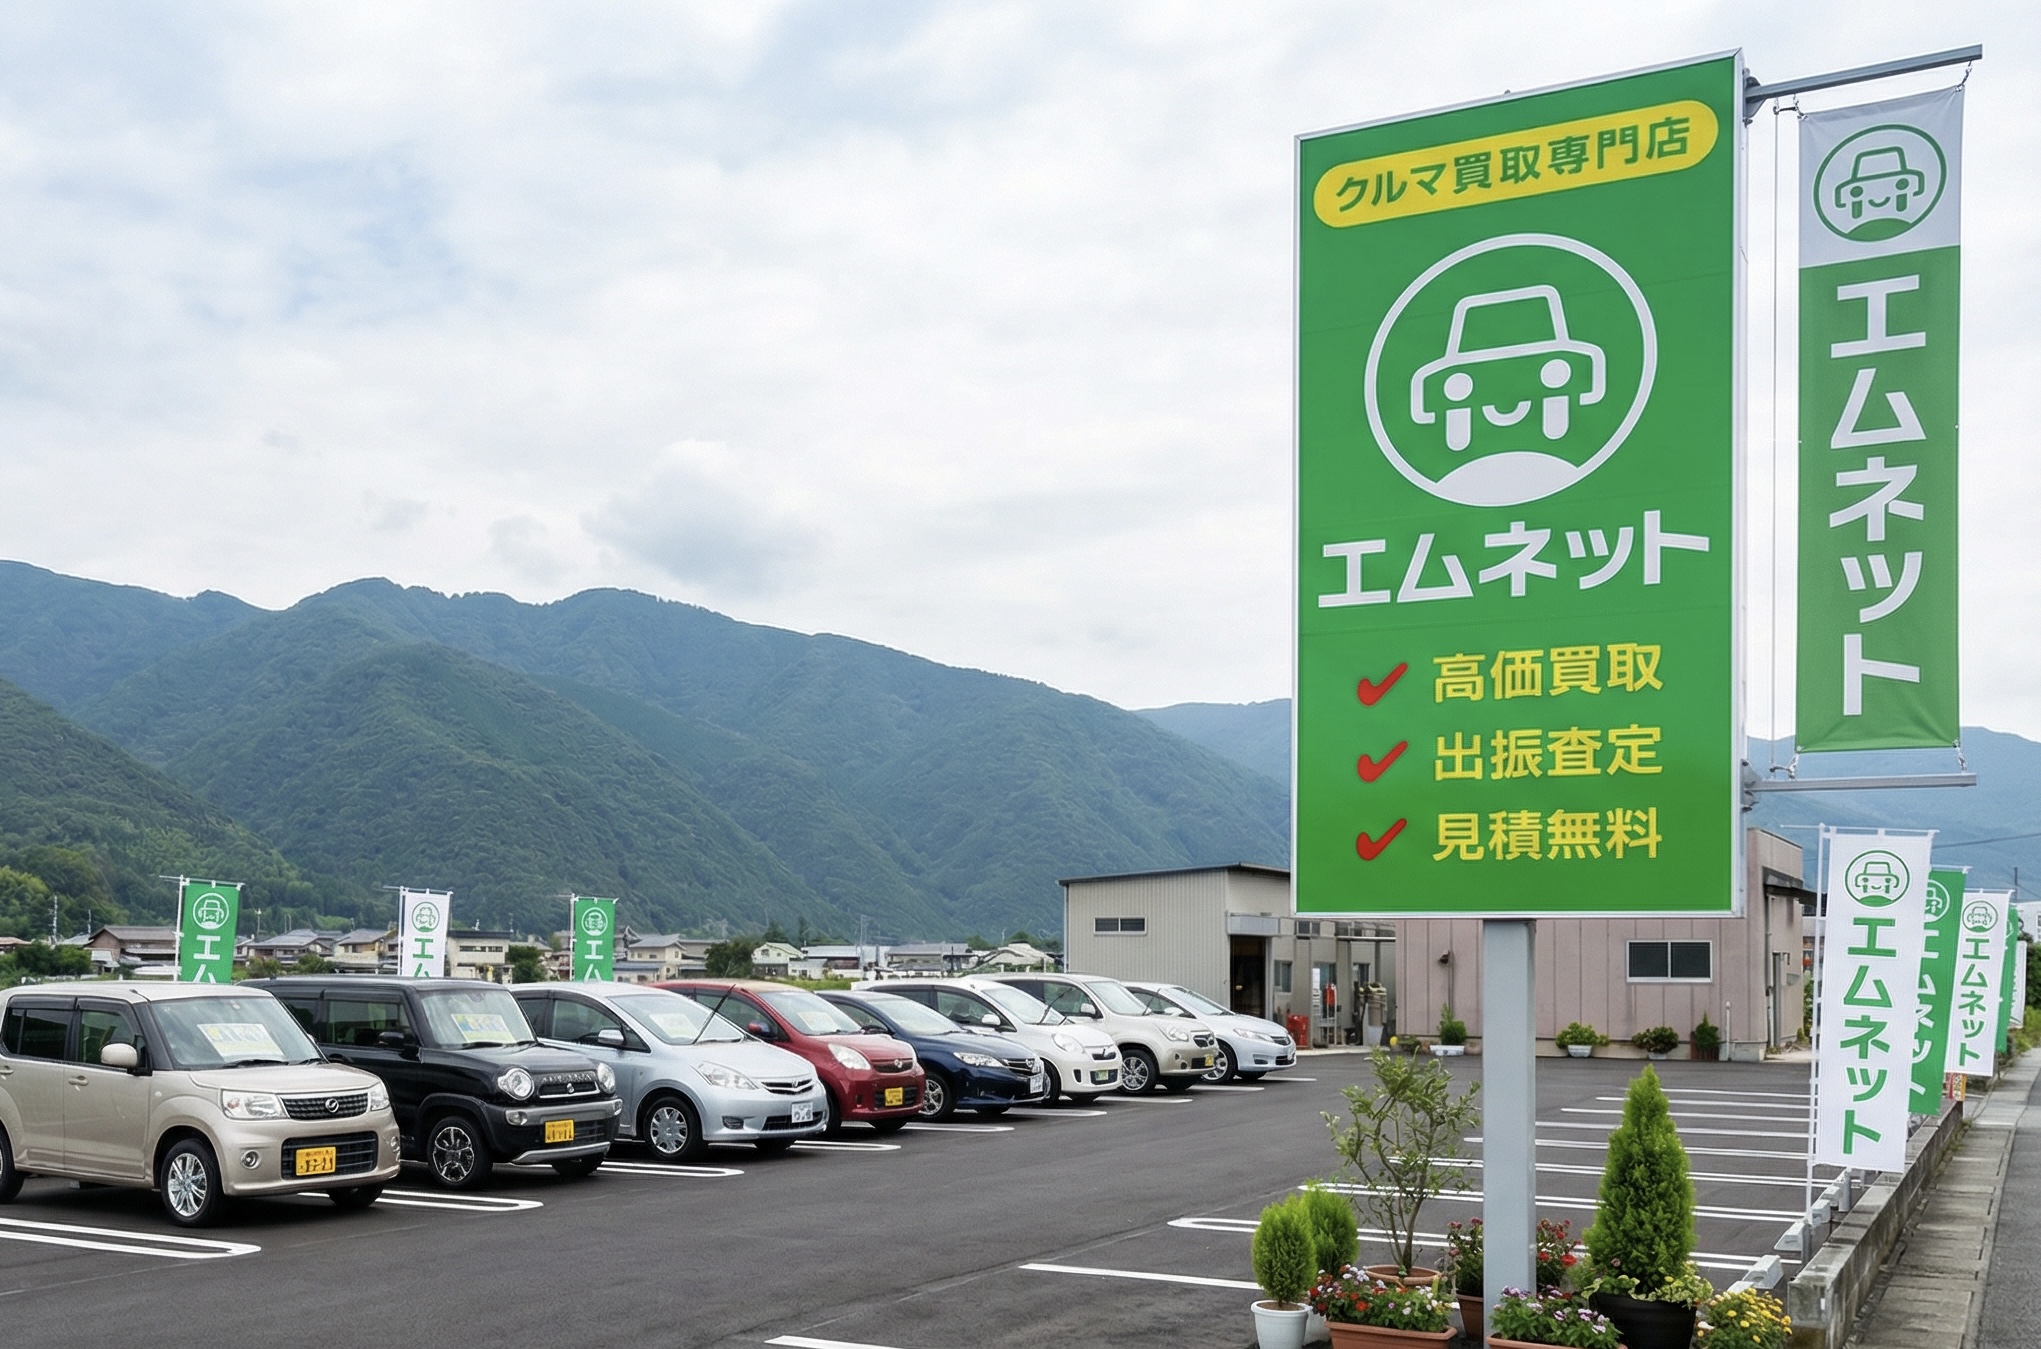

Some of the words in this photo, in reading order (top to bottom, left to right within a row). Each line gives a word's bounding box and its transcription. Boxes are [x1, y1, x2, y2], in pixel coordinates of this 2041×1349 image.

[1336, 117, 1690, 212] クルマ買取専門店
[1830, 275, 1926, 715] エムネット
[1318, 509, 1710, 608] エムネット
[1433, 643, 1663, 703] 高価買取
[1432, 807, 1662, 861] 見積無料
[1840, 916, 1898, 1156] エムネット
[1959, 938, 1990, 1066] エムネット
